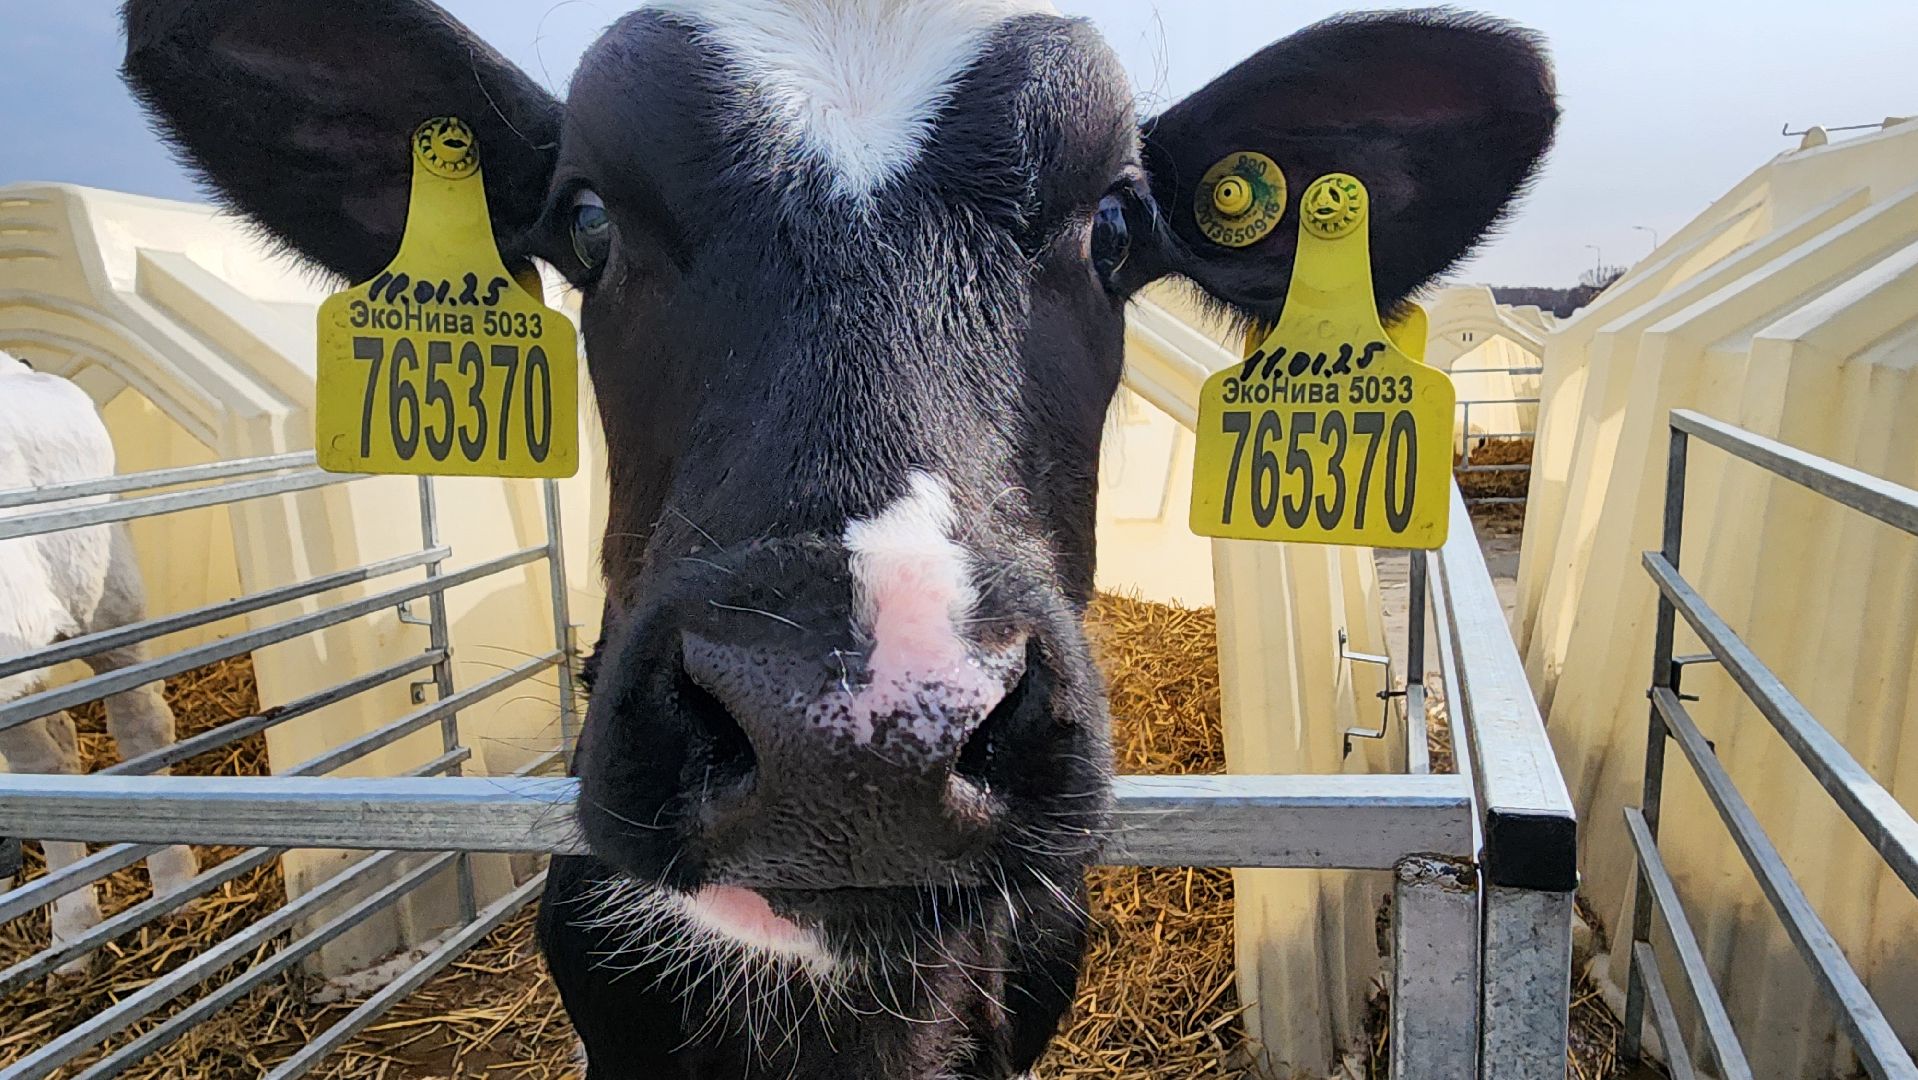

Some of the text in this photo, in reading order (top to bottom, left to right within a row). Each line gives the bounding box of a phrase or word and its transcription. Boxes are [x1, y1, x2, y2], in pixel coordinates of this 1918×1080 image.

[350, 300, 543, 339] ЭкоНива 5033
[1240, 341, 1386, 382] 11.01.25
[353, 336, 551, 463] 765370
[1222, 375, 1413, 404] ЭкоНива 5033
[1222, 409, 1417, 533] 765370
